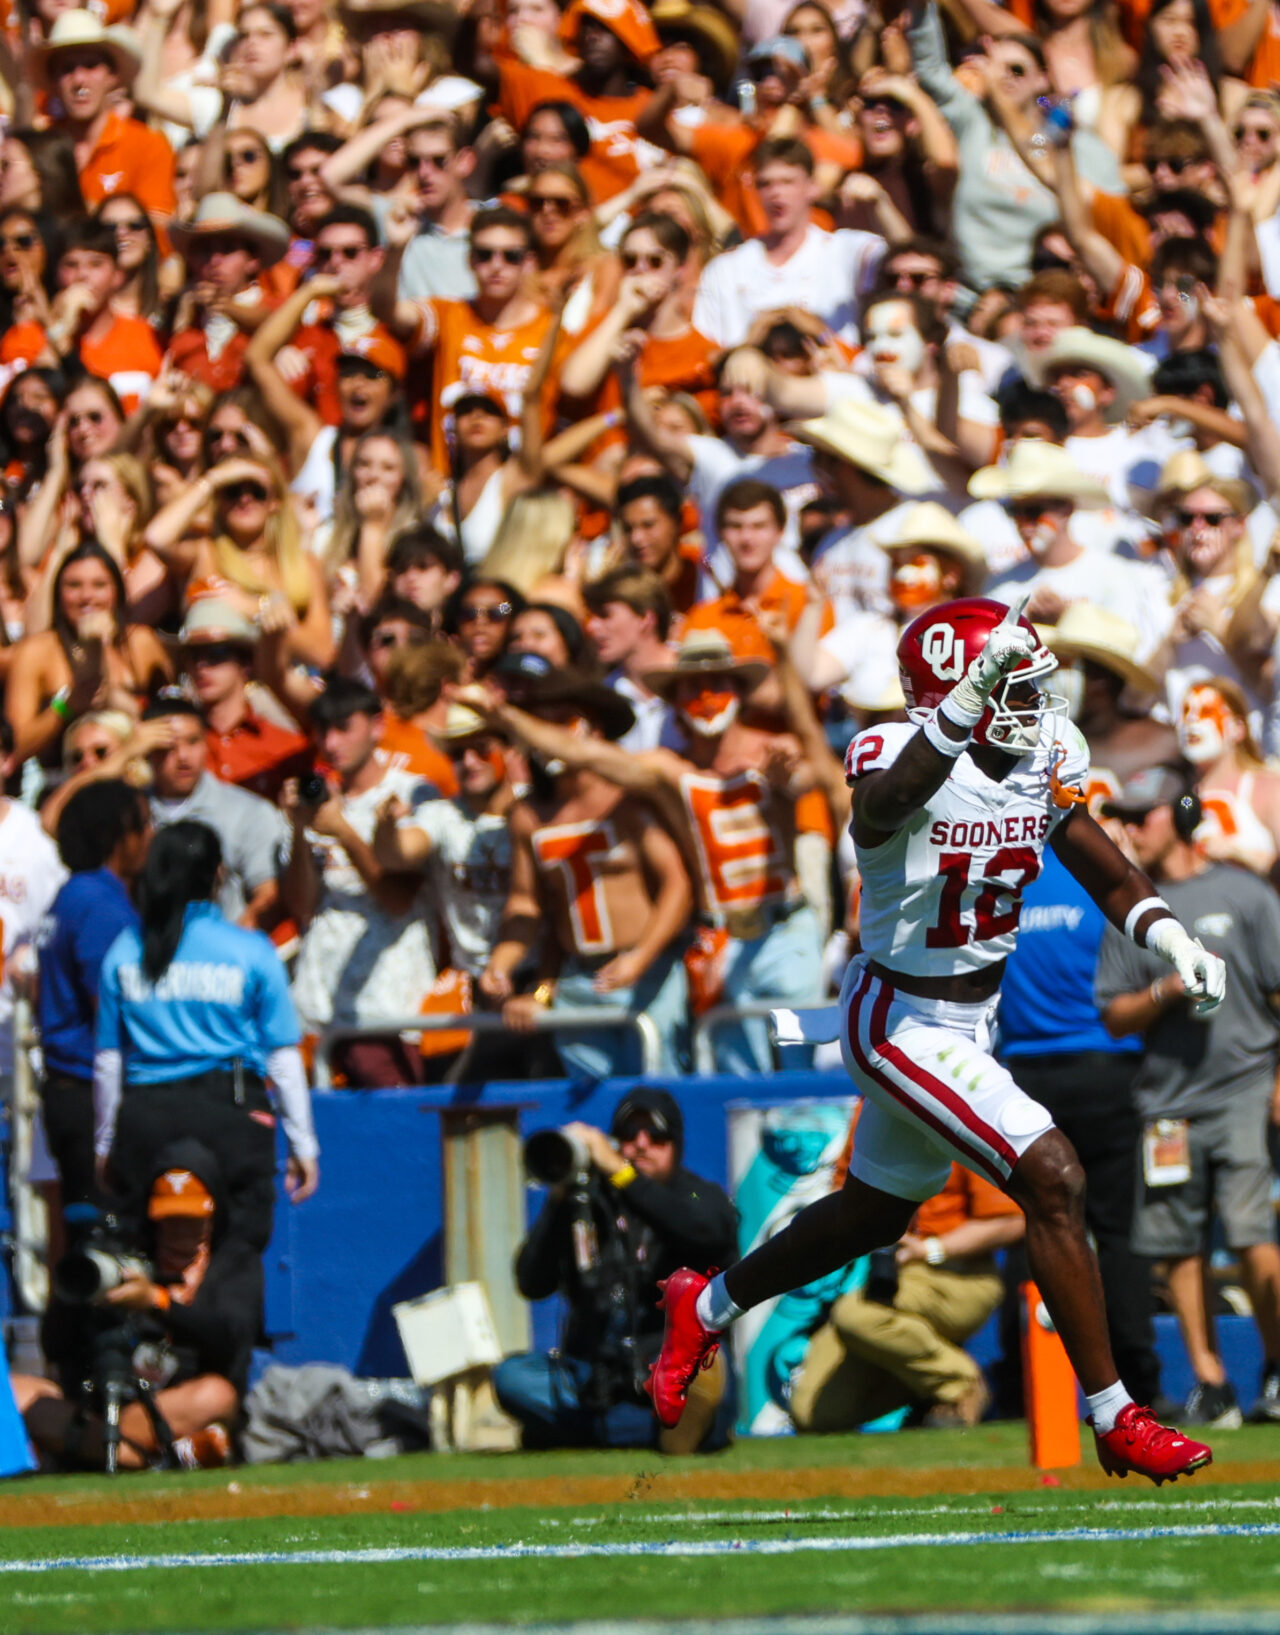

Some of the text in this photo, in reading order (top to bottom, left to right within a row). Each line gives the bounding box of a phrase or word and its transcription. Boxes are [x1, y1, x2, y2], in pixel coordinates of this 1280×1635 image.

[922, 623, 965, 682] OU
[847, 735, 884, 776] 12
[929, 814, 1053, 848] SOONERS
[925, 846, 1041, 949] 12
